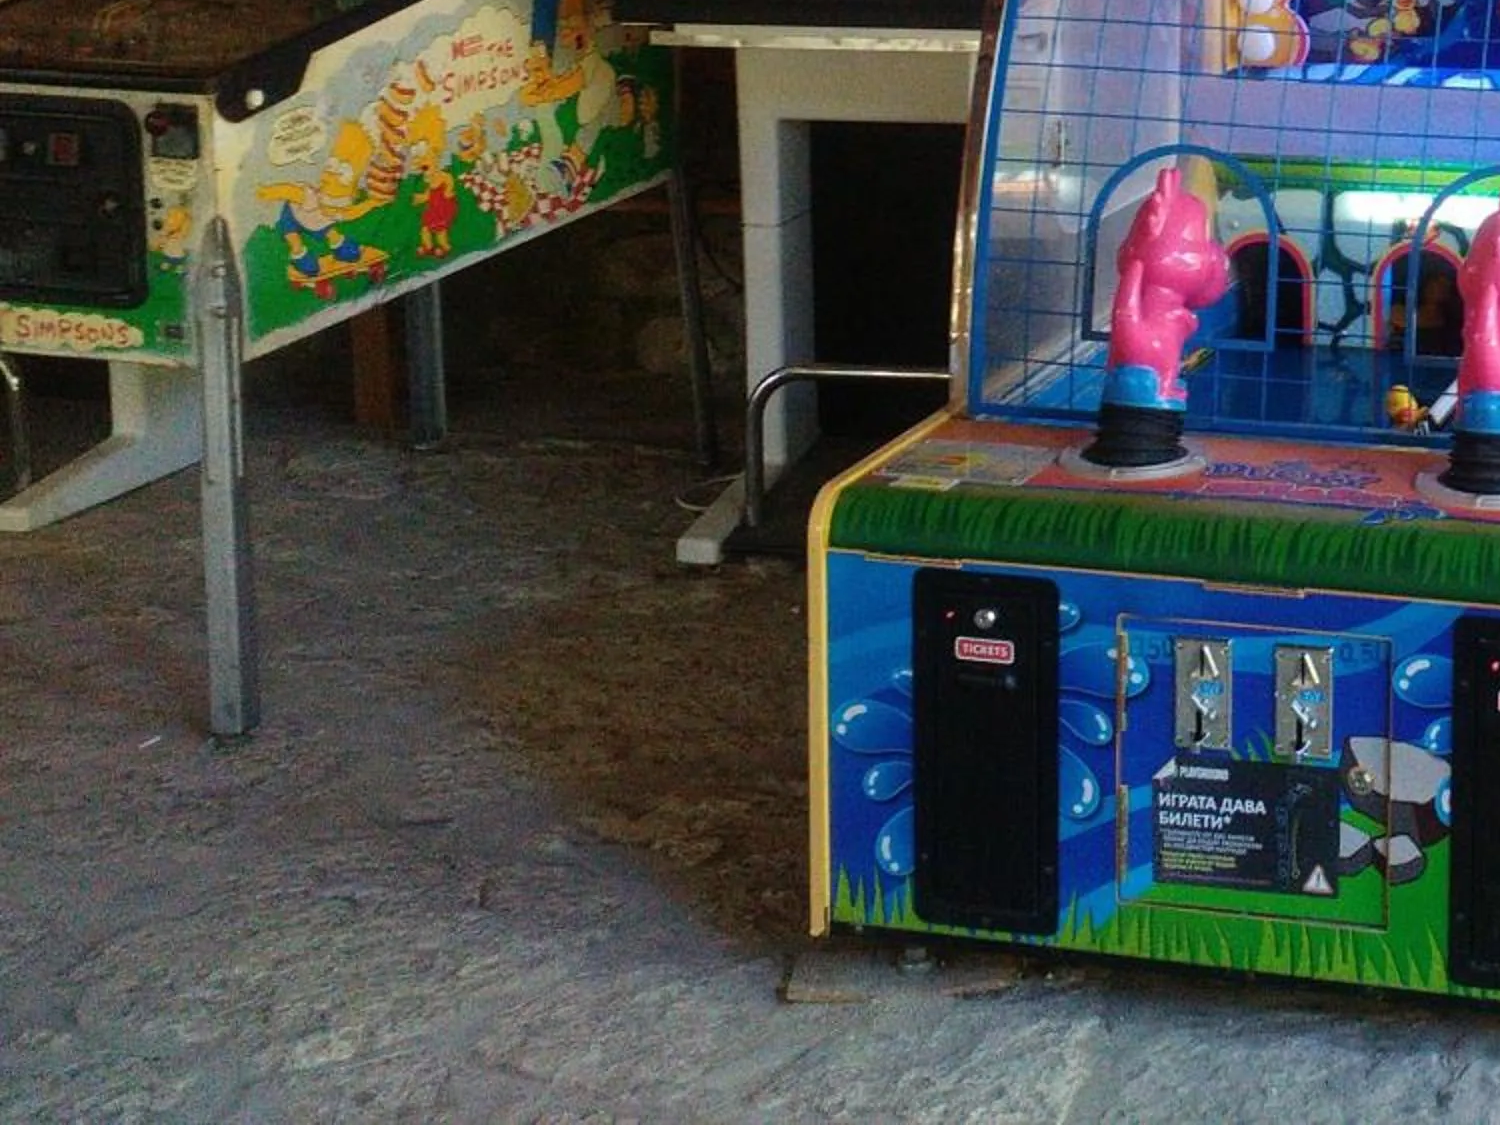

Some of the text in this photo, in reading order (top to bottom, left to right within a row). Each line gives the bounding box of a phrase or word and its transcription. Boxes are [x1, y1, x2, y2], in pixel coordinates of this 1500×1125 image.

[962, 642, 1009, 658] TICKETS
[1158, 792, 1267, 816] ИГРАТА ДАВА
